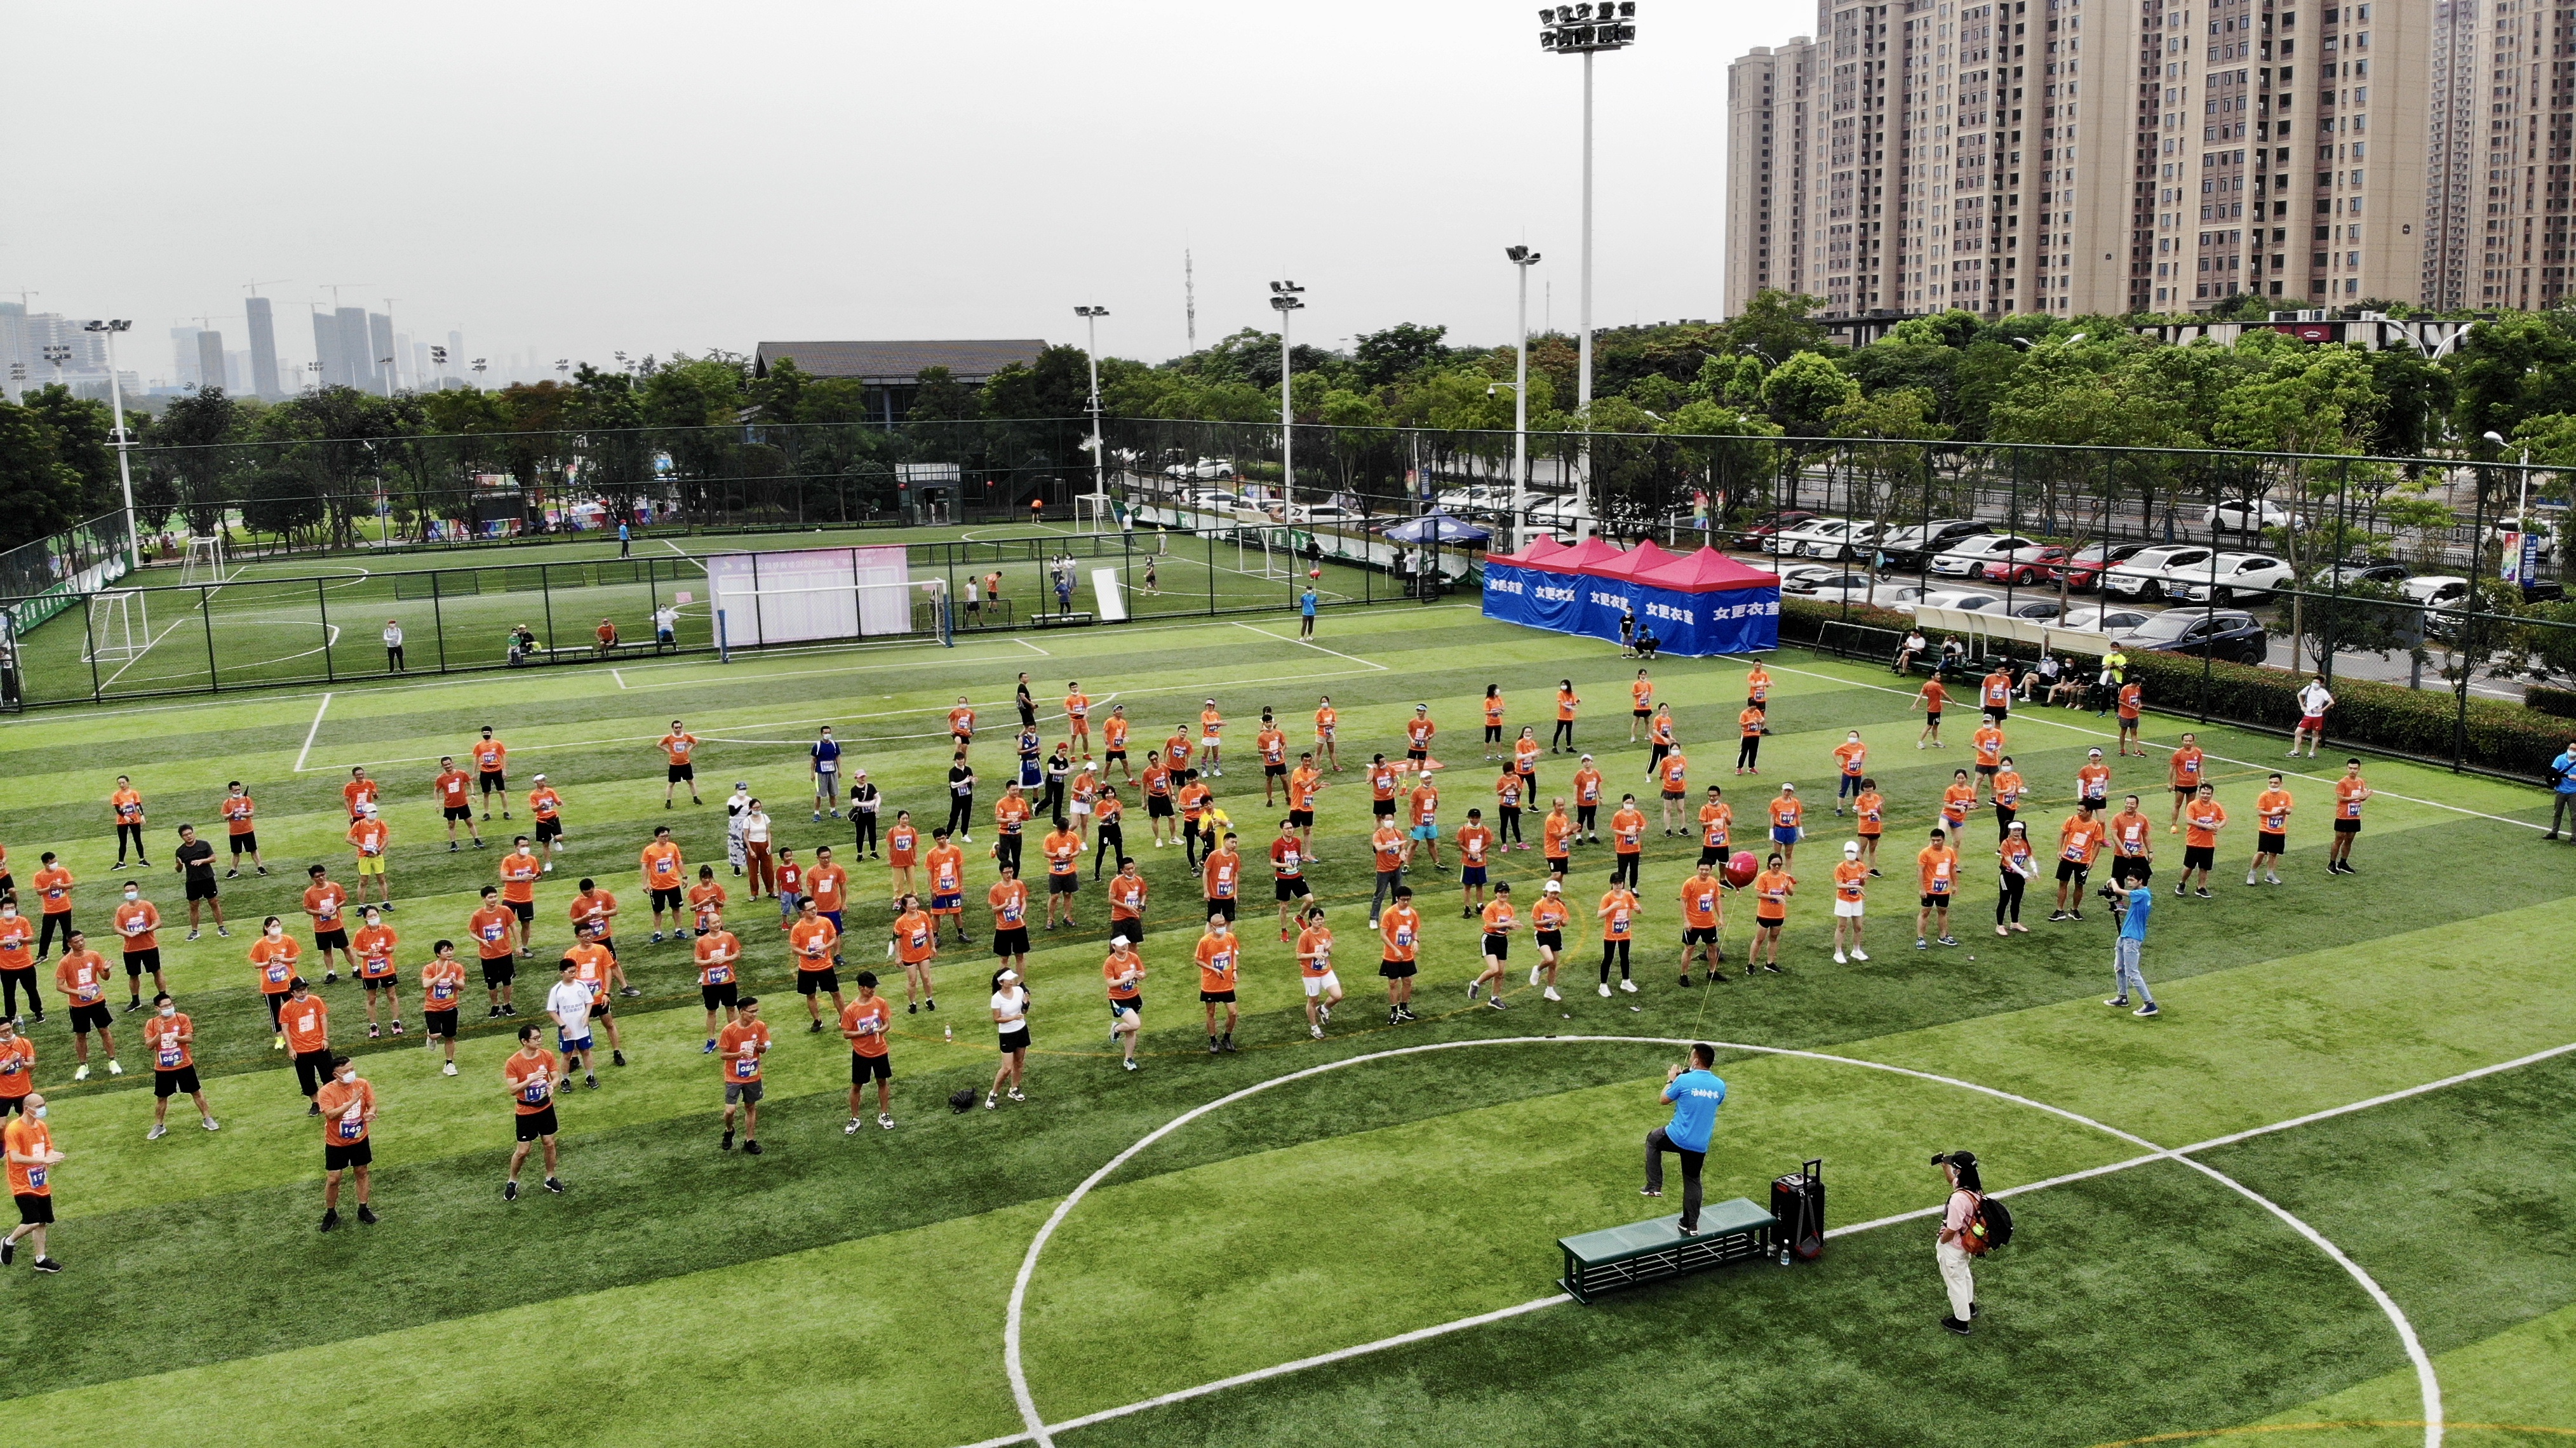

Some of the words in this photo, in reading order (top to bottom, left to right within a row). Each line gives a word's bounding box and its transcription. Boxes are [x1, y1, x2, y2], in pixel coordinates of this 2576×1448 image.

[1490, 579, 1523, 595] 女更衣室
[1646, 602, 1694, 626] 女更衣室
[1713, 601, 1780, 621] 女更衣室
